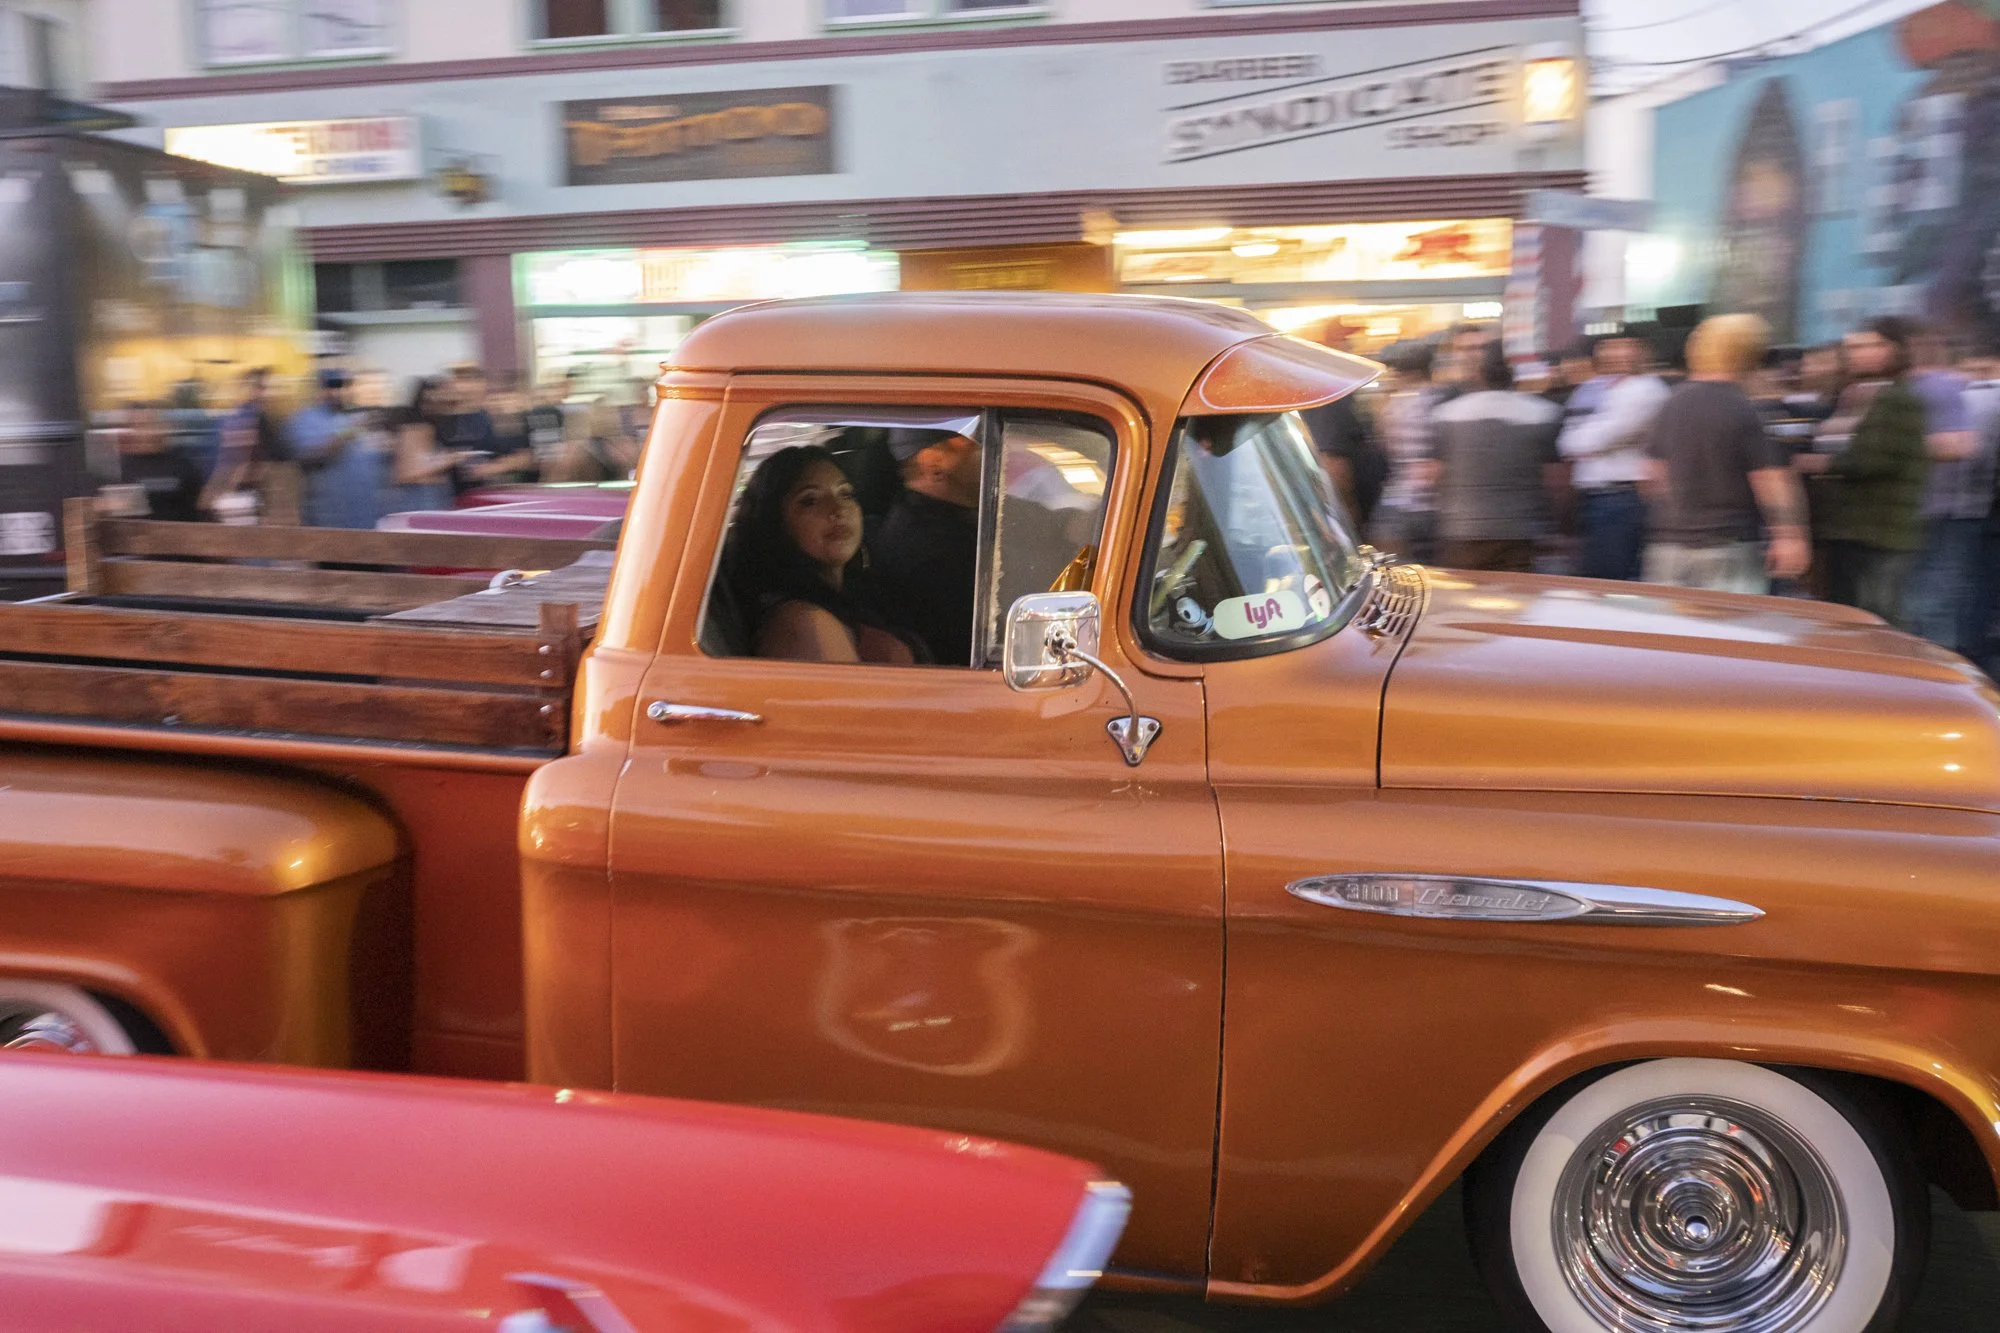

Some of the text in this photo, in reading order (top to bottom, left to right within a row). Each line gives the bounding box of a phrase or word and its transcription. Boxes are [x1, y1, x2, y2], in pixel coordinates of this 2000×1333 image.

[1164, 53, 1322, 84] BARBER
[1165, 59, 1513, 155] SYNDICATE
[1386, 122, 1507, 149] SHOP
[1243, 598, 1284, 629] lyft
[1417, 887, 1551, 911] Chevrolet
